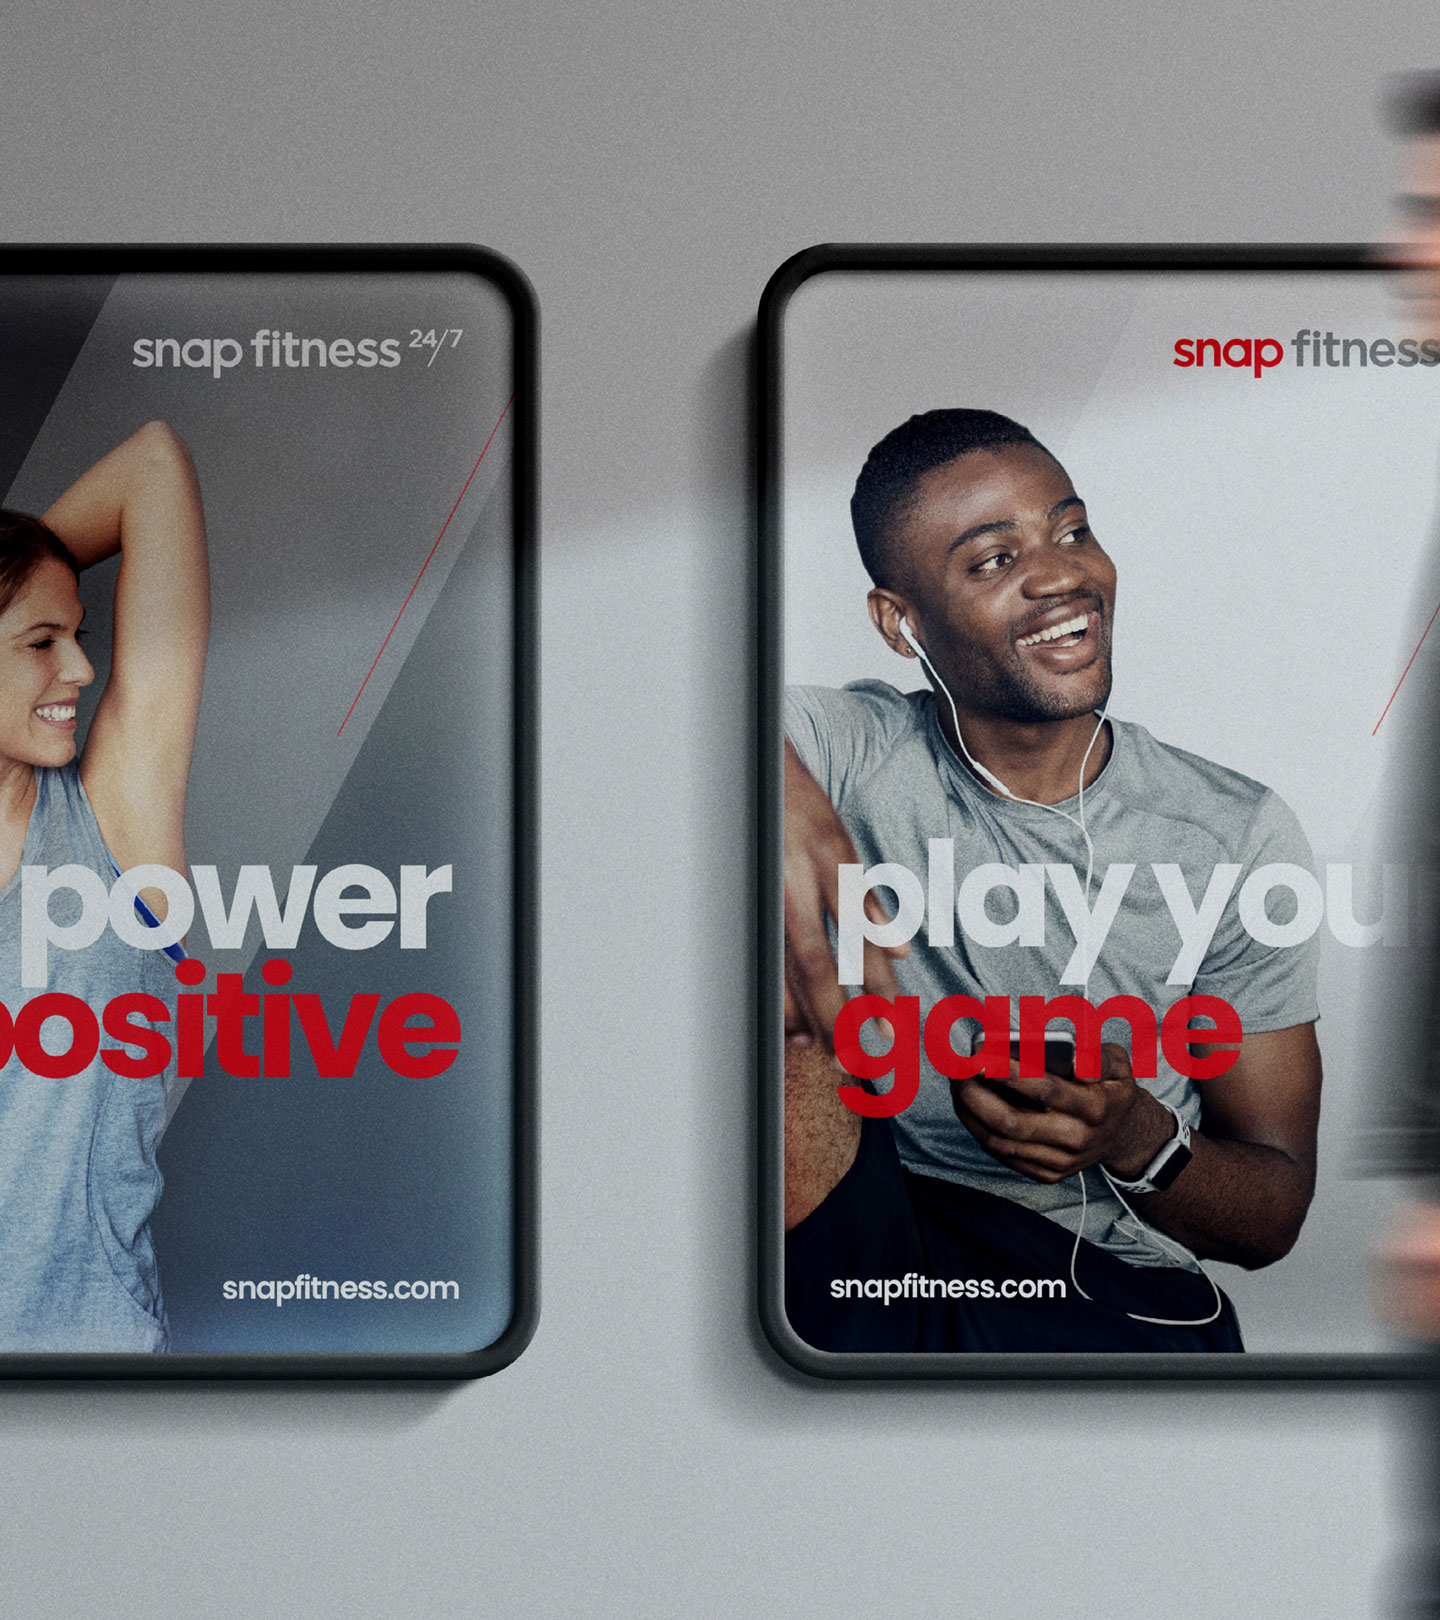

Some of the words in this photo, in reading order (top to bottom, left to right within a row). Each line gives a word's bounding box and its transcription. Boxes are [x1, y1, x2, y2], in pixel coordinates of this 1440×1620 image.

[132, 338, 243, 379] snap
[250, 329, 402, 368] fitness
[408, 328, 464, 367] 24/7
[1173, 338, 1284, 379] snap
[1291, 328, 1440, 368] fitness
[21, 863, 453, 988] power
[837, 837, 1137, 986] play
[0, 958, 462, 1079] ositive
[832, 993, 1244, 1119] game
[222, 1273, 460, 1308] snapfitness.com
[829, 1272, 1068, 1306] snapfitness.com
